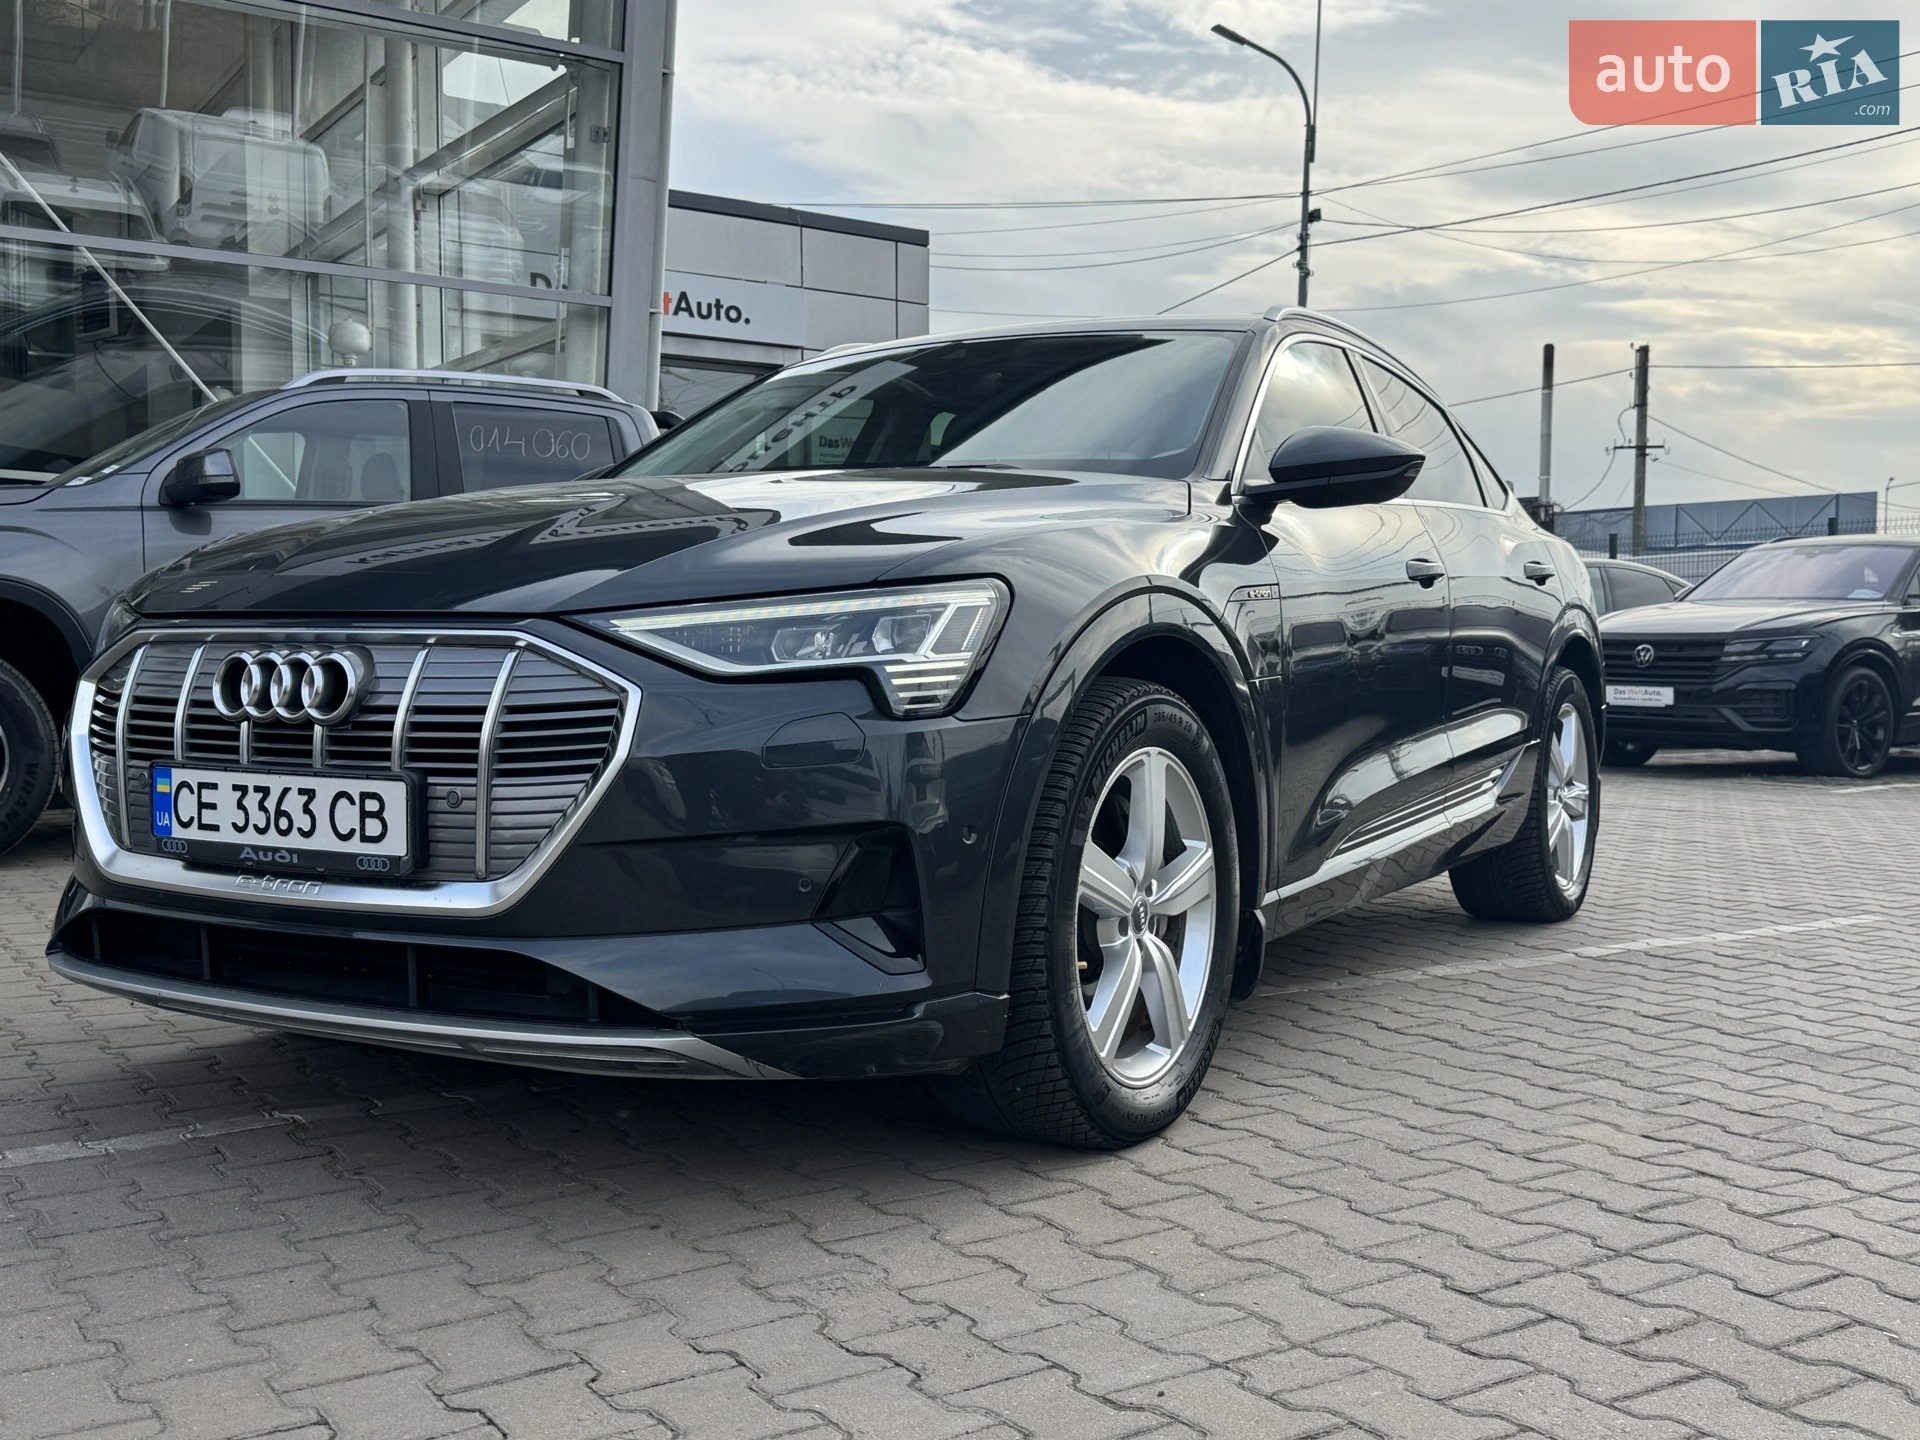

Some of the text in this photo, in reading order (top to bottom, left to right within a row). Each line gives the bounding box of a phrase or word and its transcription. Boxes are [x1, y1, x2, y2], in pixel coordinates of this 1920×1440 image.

[470, 425, 591, 460] 014 060
[1092, 712, 1146, 792] MICHELIN
[157, 811, 170, 827] UA
[173, 780, 389, 844] CE 3363 CB
[239, 846, 299, 864] Audi
[235, 874, 323, 895] e-tron
